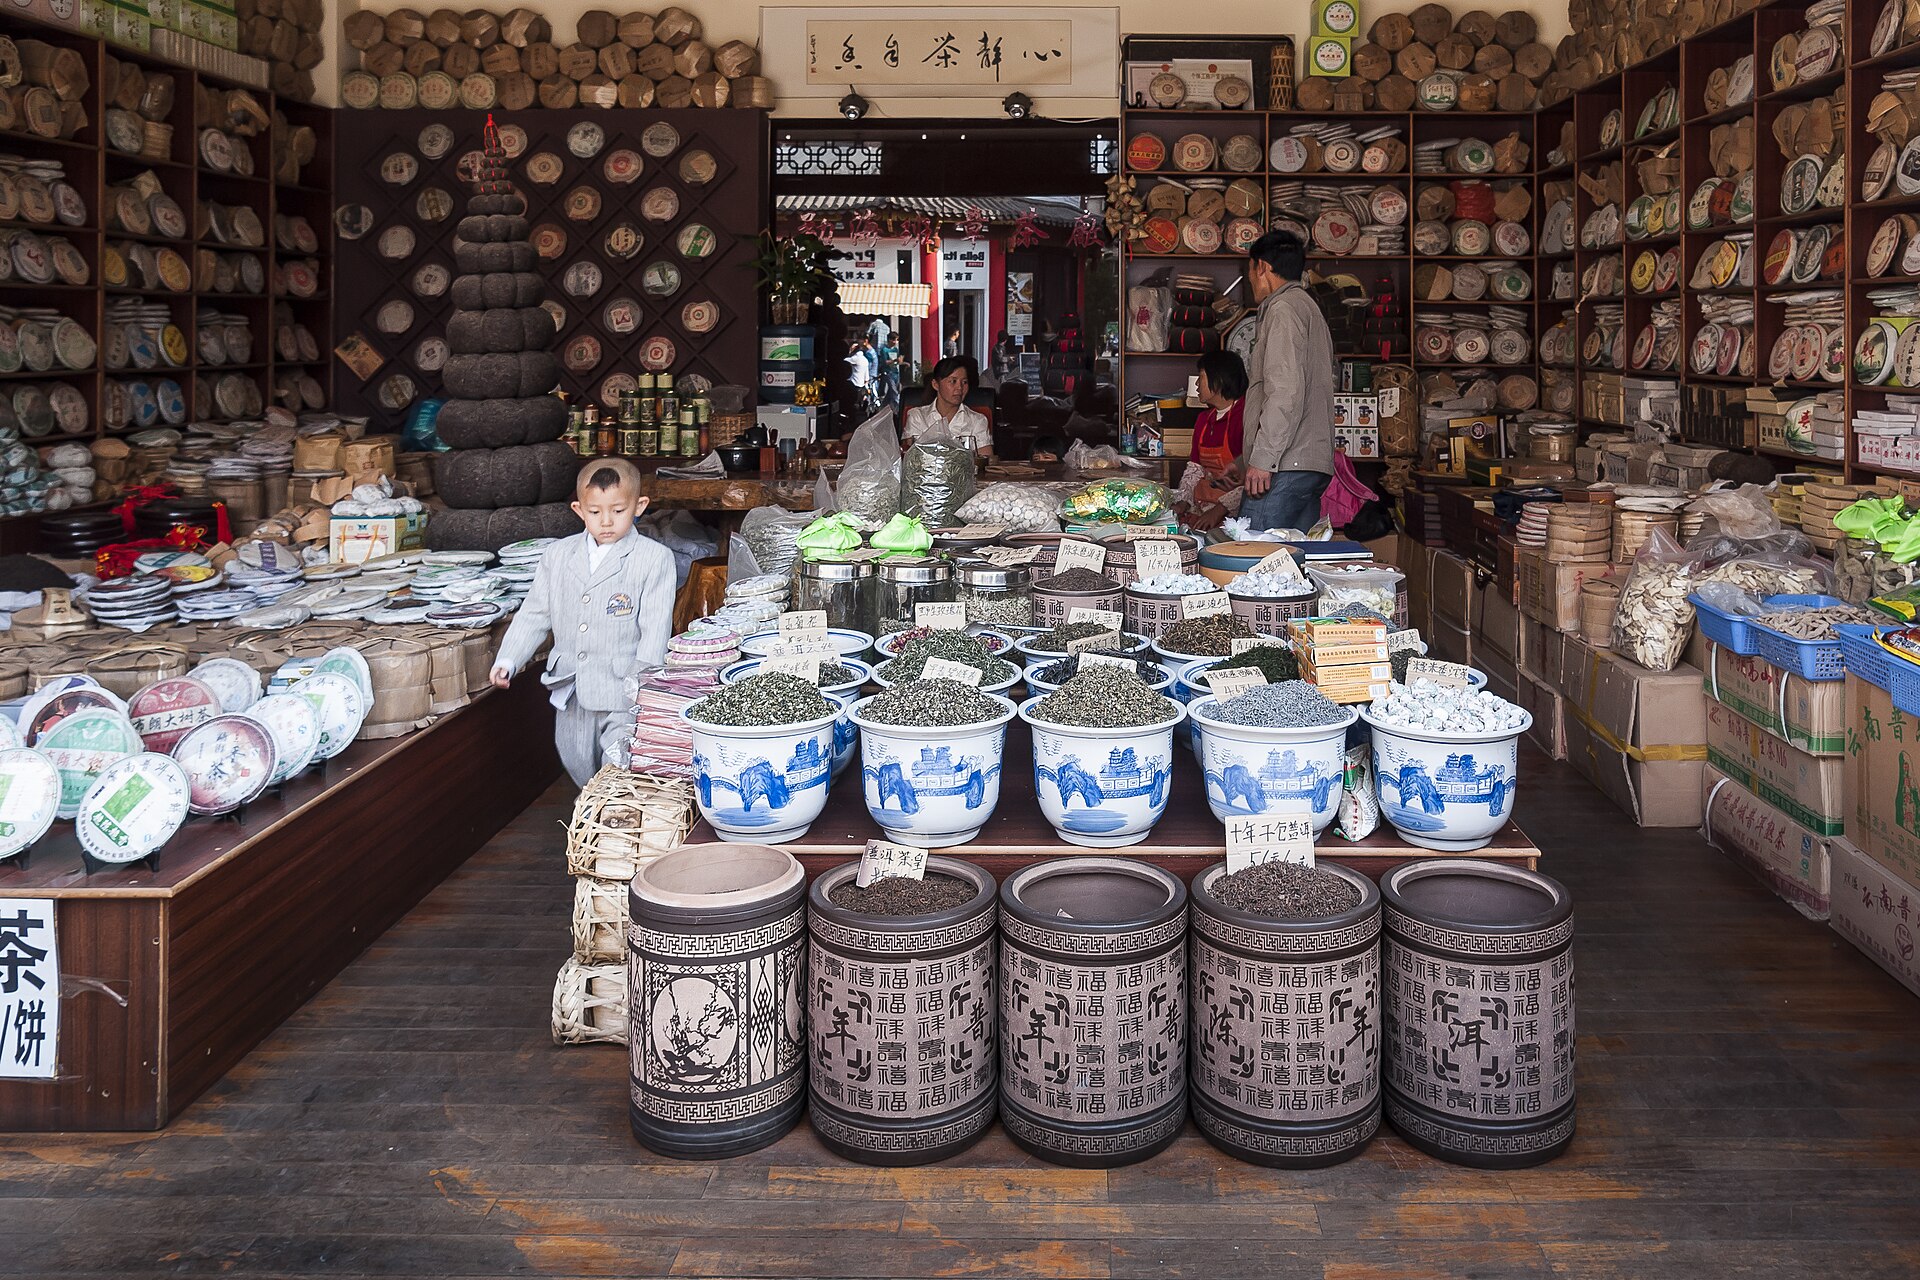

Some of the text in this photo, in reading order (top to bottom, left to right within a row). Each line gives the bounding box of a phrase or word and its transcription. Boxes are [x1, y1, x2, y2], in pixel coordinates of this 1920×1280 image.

[825, 1005, 858, 1057] 年
[1021, 1007, 1055, 1060] 年
[1345, 1005, 1373, 1051] 年
[1449, 1017, 1491, 1063] 洱
